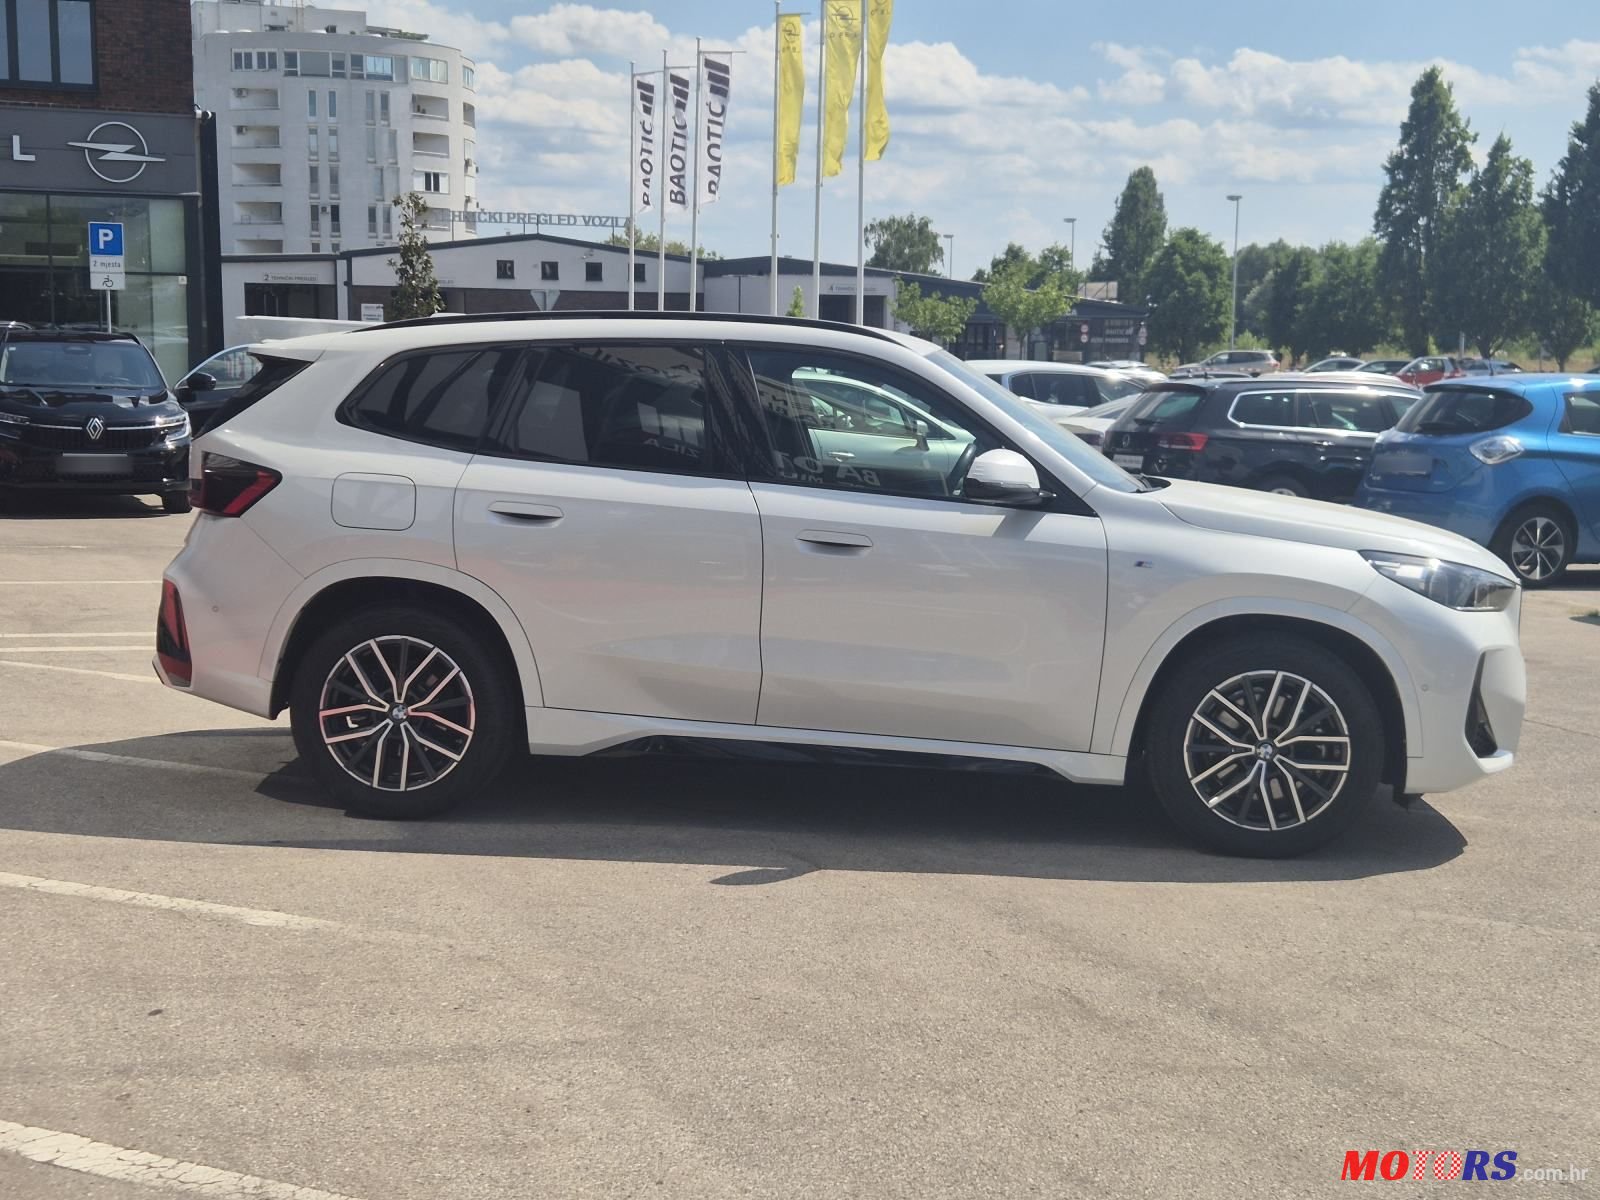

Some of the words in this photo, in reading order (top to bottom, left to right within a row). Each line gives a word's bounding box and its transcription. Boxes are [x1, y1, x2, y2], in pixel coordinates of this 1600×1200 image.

[12, 135, 36, 161] L
[669, 116, 688, 206] BAOTIĆ
[507, 212, 577, 226] PREGLED
[582, 215, 632, 227] VOZILA
[99, 229, 113, 249] P
[100, 261, 121, 269] mjesta
